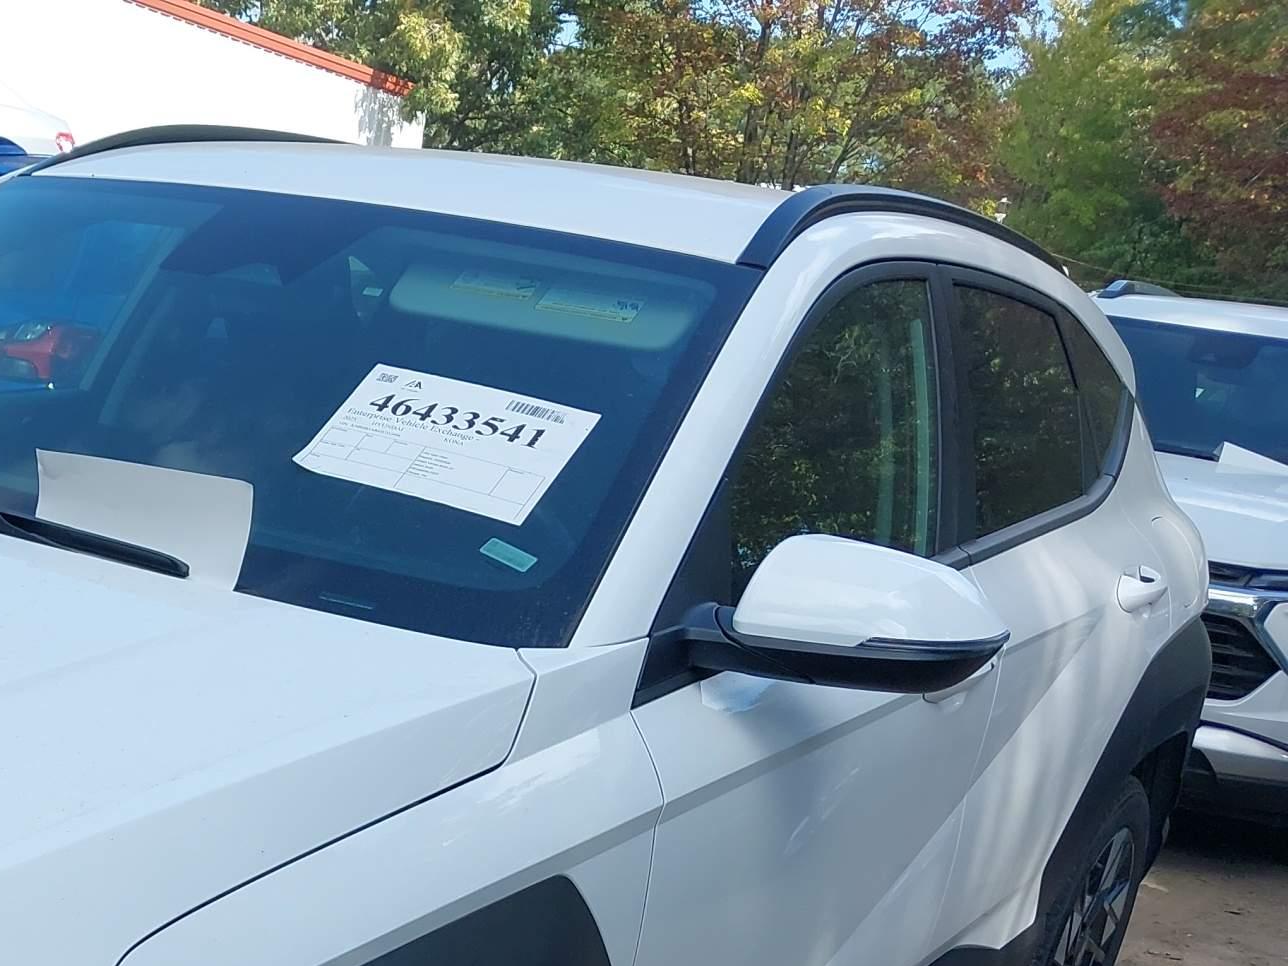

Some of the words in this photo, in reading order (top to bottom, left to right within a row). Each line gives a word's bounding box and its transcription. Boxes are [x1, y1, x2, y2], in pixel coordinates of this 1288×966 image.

[347, 408, 393, 421] Enterprise
[395, 416, 429, 431] Vehicle
[430, 425, 475, 442] Exchange
[369, 393, 546, 449] 46433541
